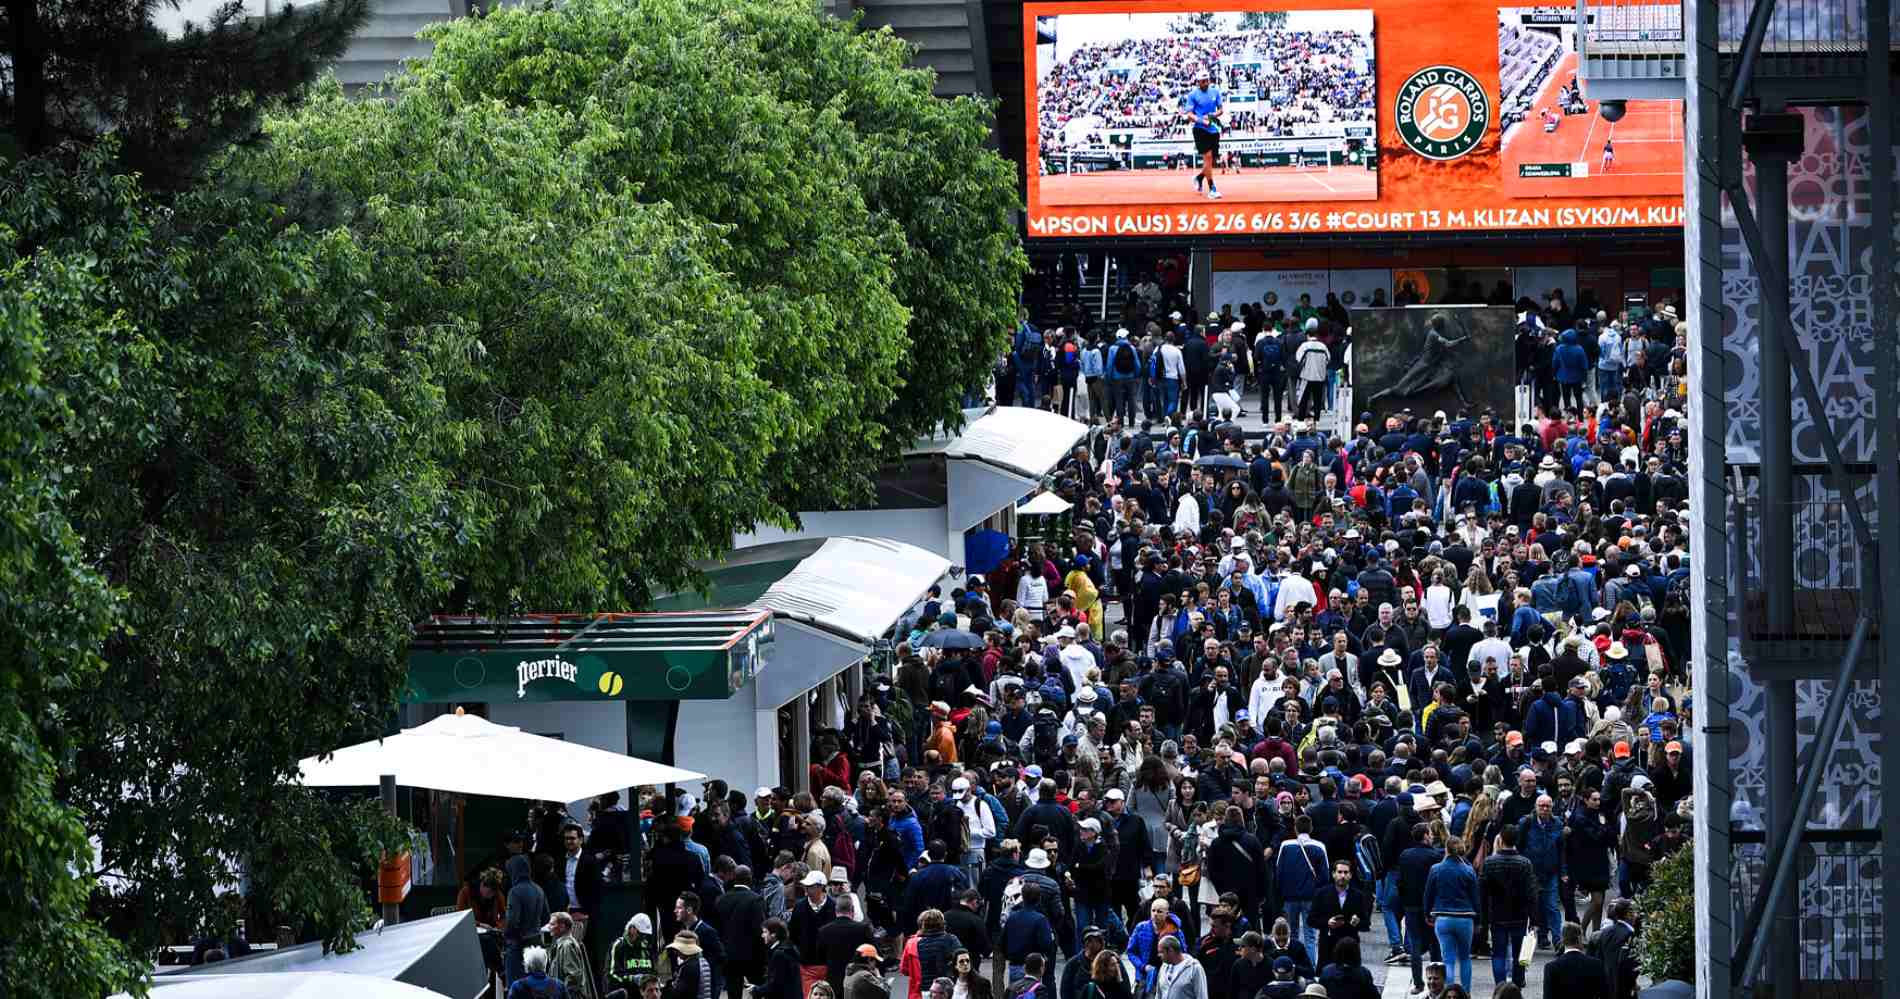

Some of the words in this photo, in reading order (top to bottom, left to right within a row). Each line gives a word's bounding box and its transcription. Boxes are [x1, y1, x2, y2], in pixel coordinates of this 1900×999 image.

[1400, 71, 1439, 124] ROLAND
[1444, 71, 1484, 123] GARROS
[1414, 136, 1472, 154] PARIS
[1115, 214, 1171, 233] (AUS)
[1177, 214, 1208, 231] 3/6
[1215, 213, 1246, 231] 2/6
[1251, 212, 1283, 230] 6/6
[1288, 212, 1320, 230] 3/6
[1326, 211, 1415, 229] #COURT
[1420, 210, 1440, 228] 13
[1447, 208, 1550, 227] M.KLIZAN
[516, 654, 578, 698] perrier
